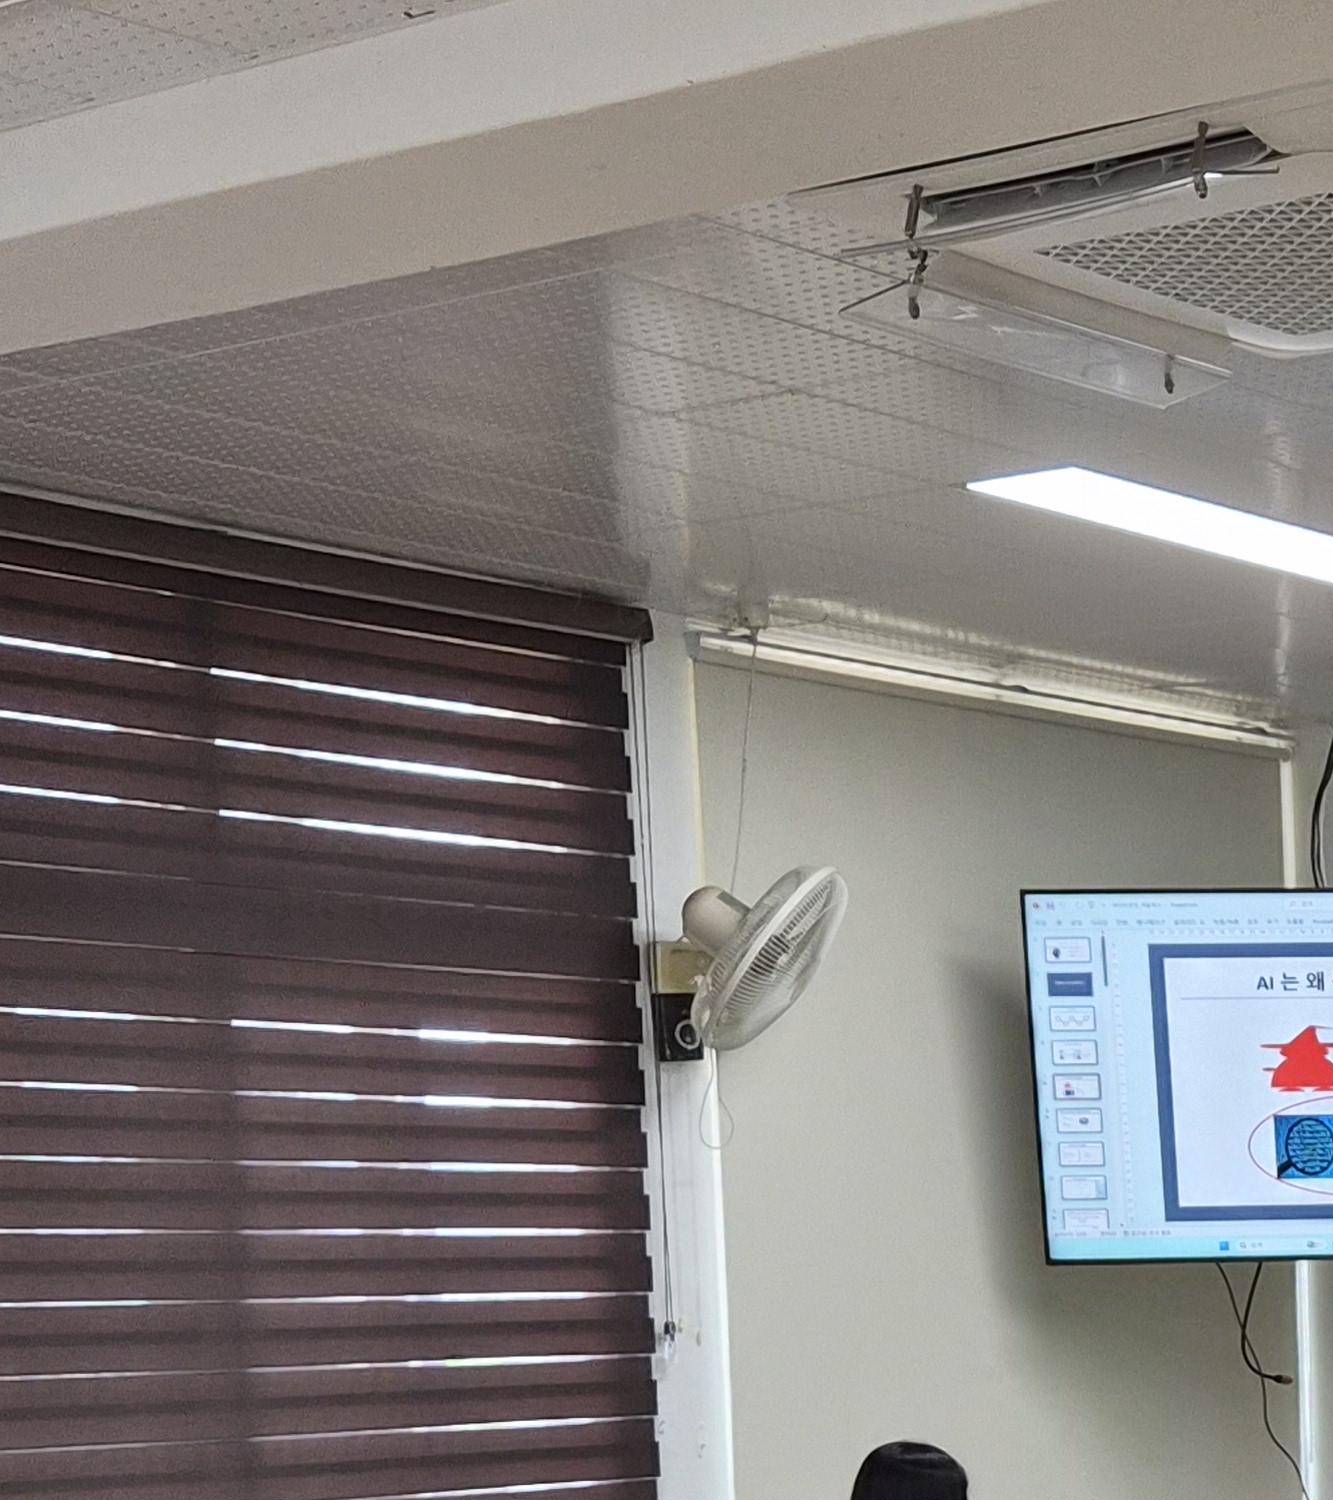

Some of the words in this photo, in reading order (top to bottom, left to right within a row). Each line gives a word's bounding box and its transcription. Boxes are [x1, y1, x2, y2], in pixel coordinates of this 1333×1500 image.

[1256, 976, 1274, 991] AI
[1280, 972, 1300, 992] 는
[1306, 971, 1325, 992] 왜
